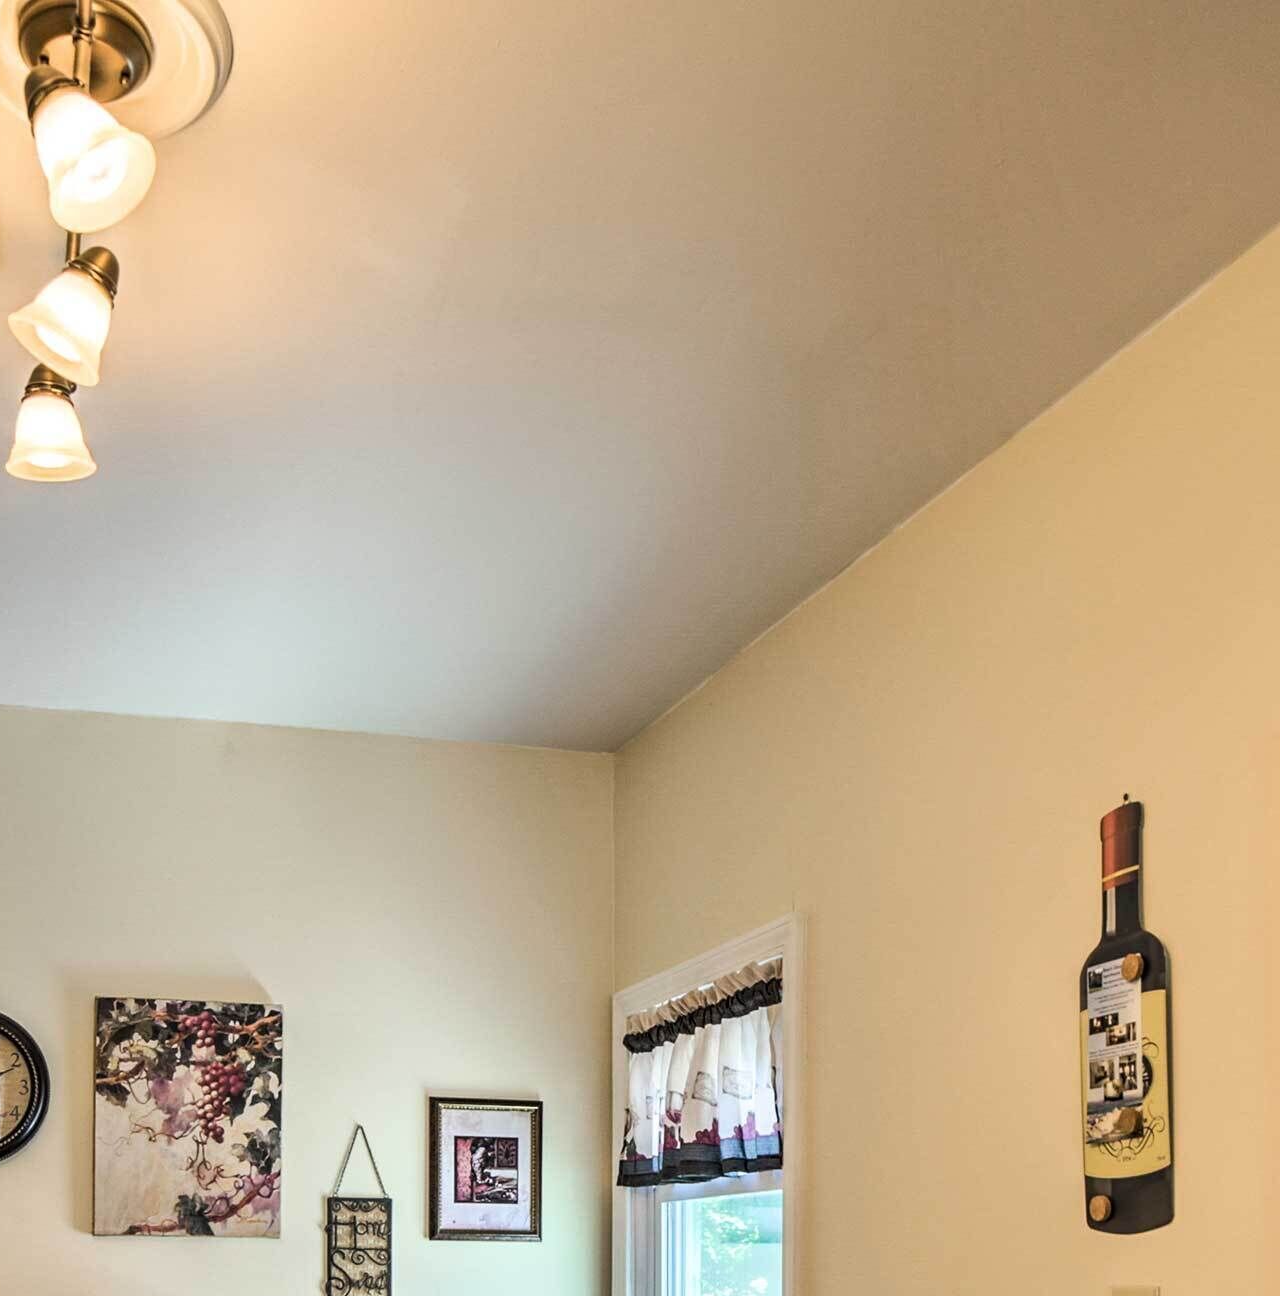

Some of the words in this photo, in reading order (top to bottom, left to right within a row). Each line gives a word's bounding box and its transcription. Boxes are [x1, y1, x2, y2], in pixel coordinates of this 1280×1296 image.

[10, 1052, 22, 1068] 2
[18, 1079, 29, 1095] 3
[9, 1105, 21, 1121] 4
